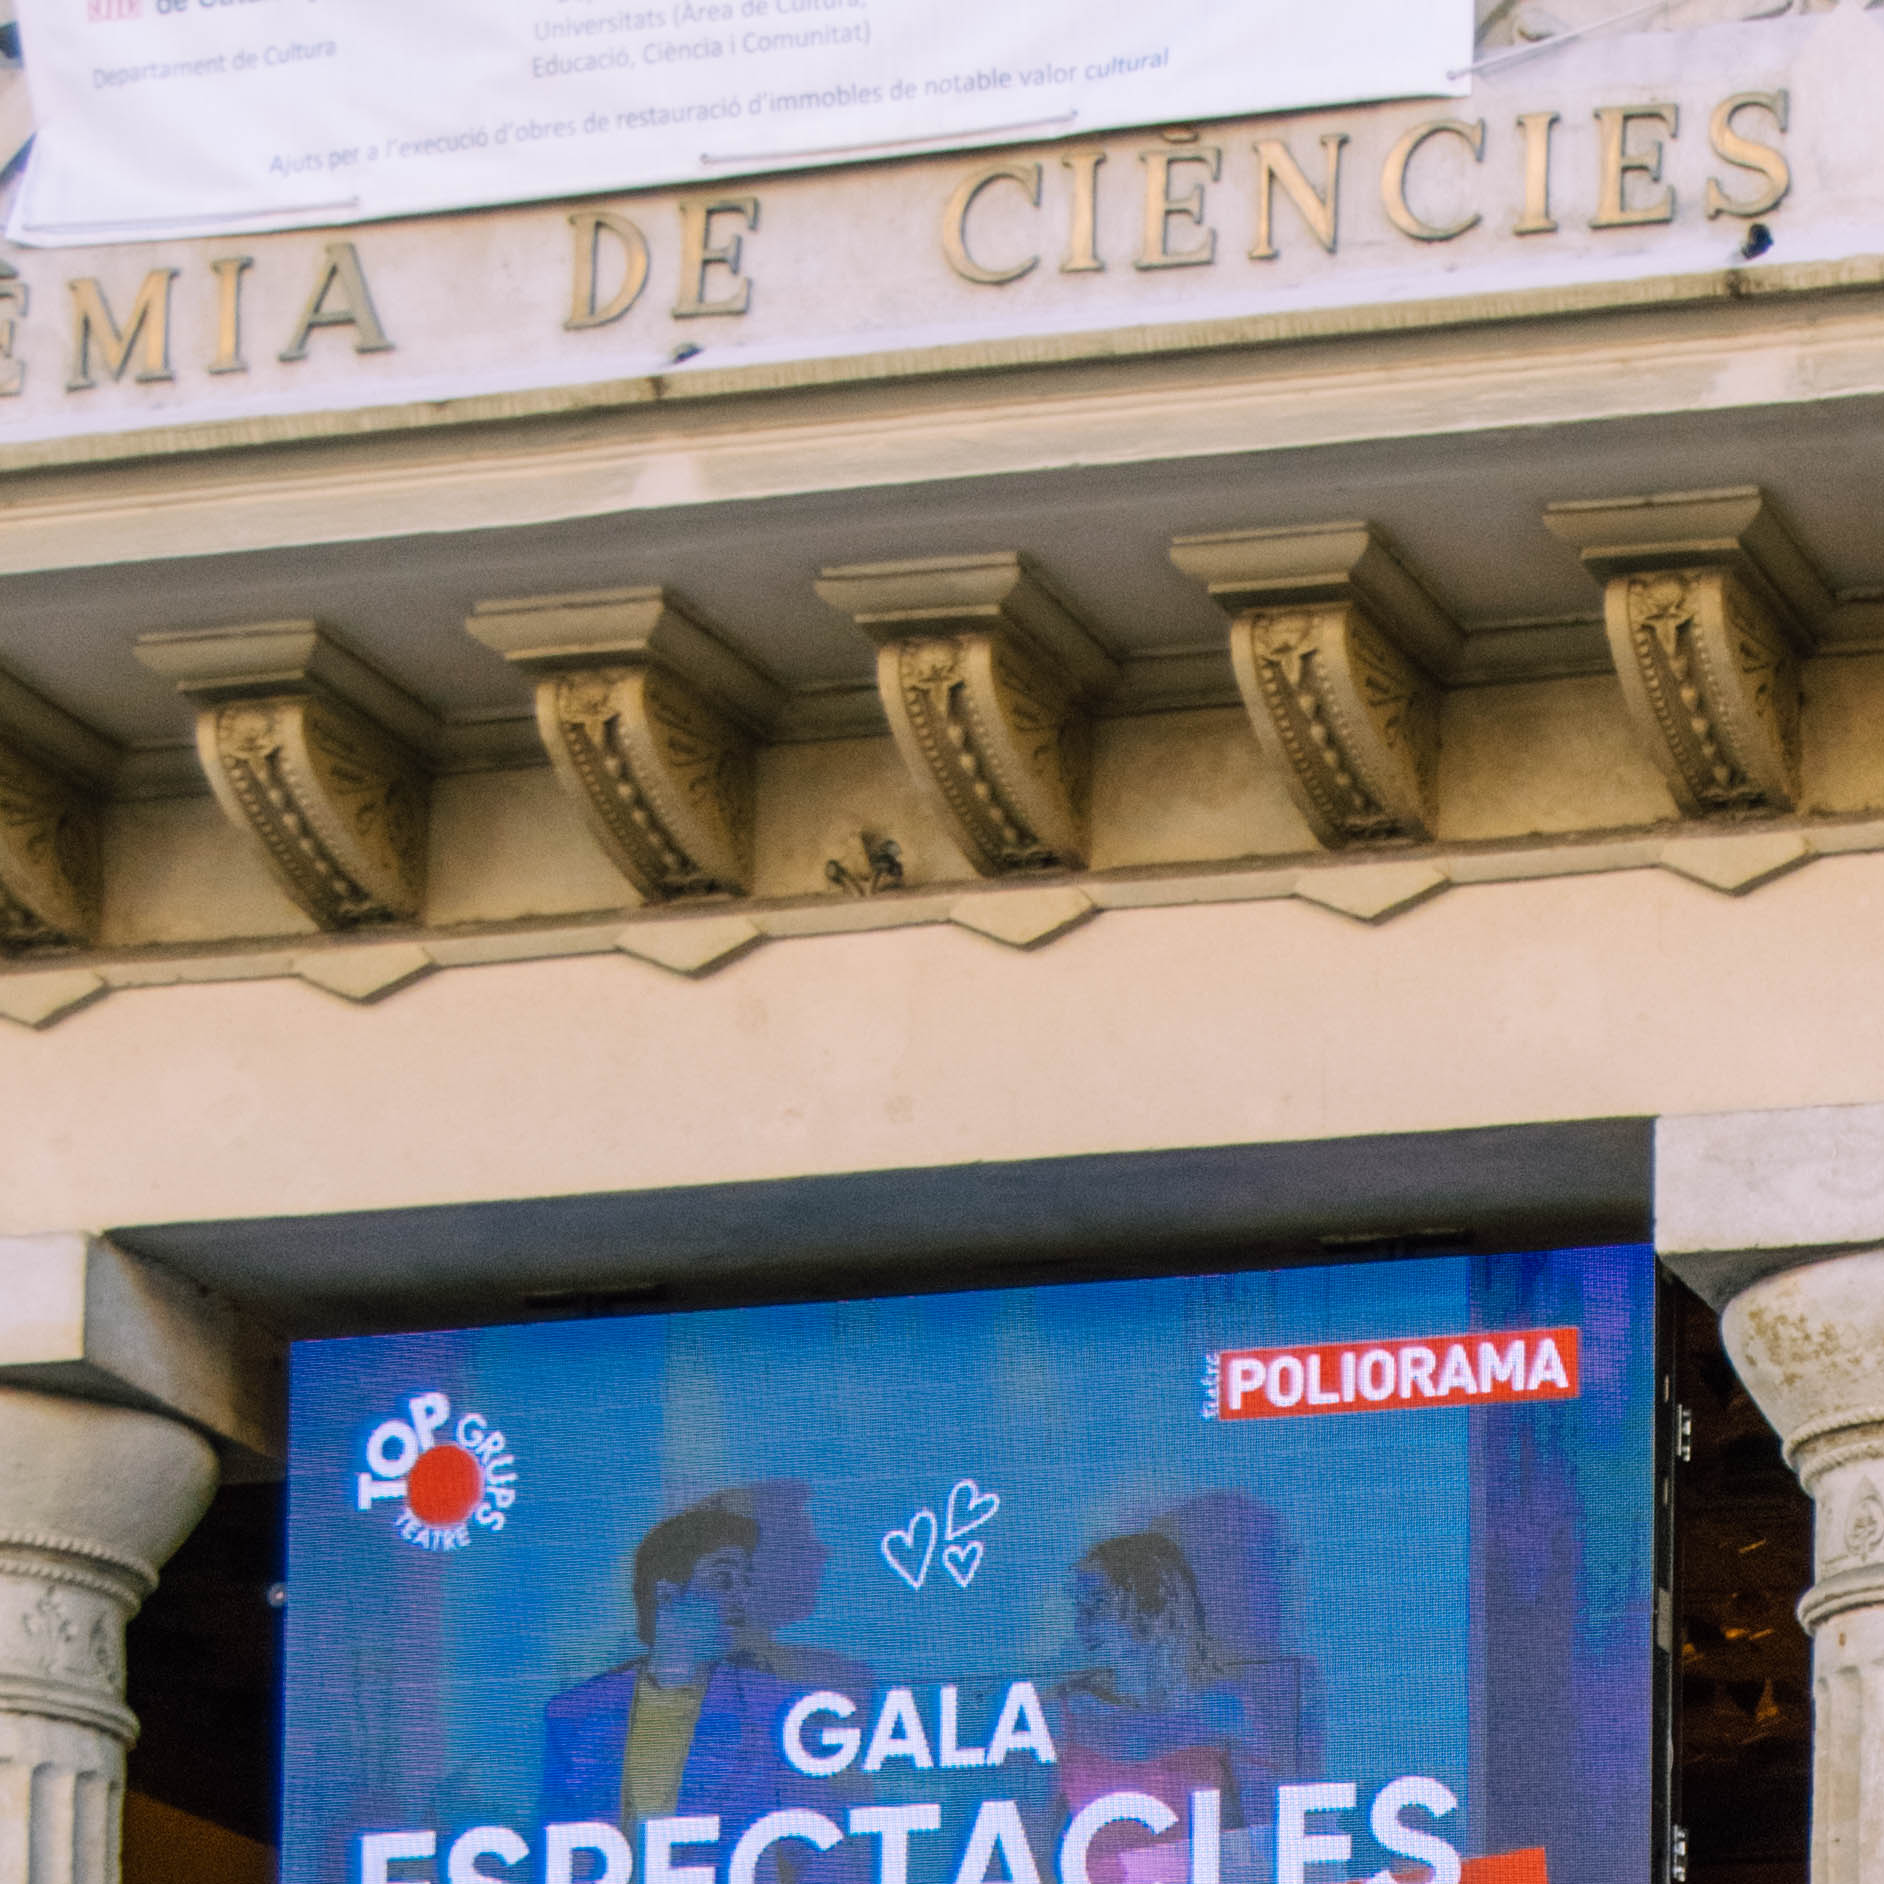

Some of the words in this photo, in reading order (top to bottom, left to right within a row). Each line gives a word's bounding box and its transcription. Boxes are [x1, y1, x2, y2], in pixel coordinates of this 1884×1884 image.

[92, 52, 227, 89] Departament
[232, 48, 259, 71] de
[263, 40, 337, 66] Cultura
[531, 49, 636, 79] Educació,
[643, 37, 723, 64] Ciència
[743, 20, 872, 55] Comunitat)
[534, 7, 667, 42] Universitats
[269, 152, 323, 178] Ajuts
[328, 150, 359, 172] per
[368, 147, 379, 161] a
[584, 112, 611, 134] de
[617, 94, 742, 130] restauració
[890, 79, 918, 101] de
[925, 68, 1013, 97] notable
[1019, 63, 1077, 87] valor
[1084, 48, 1170, 82] cultural
[562, 195, 762, 332] DE
[941, 88, 1795, 286] CIÈNCIES
[1228, 1337, 1570, 1410] POLIORAMA
[357, 1391, 450, 1511] TOP
[456, 1413, 518, 1532] GRUPS
[780, 1677, 1059, 1778] GALA
